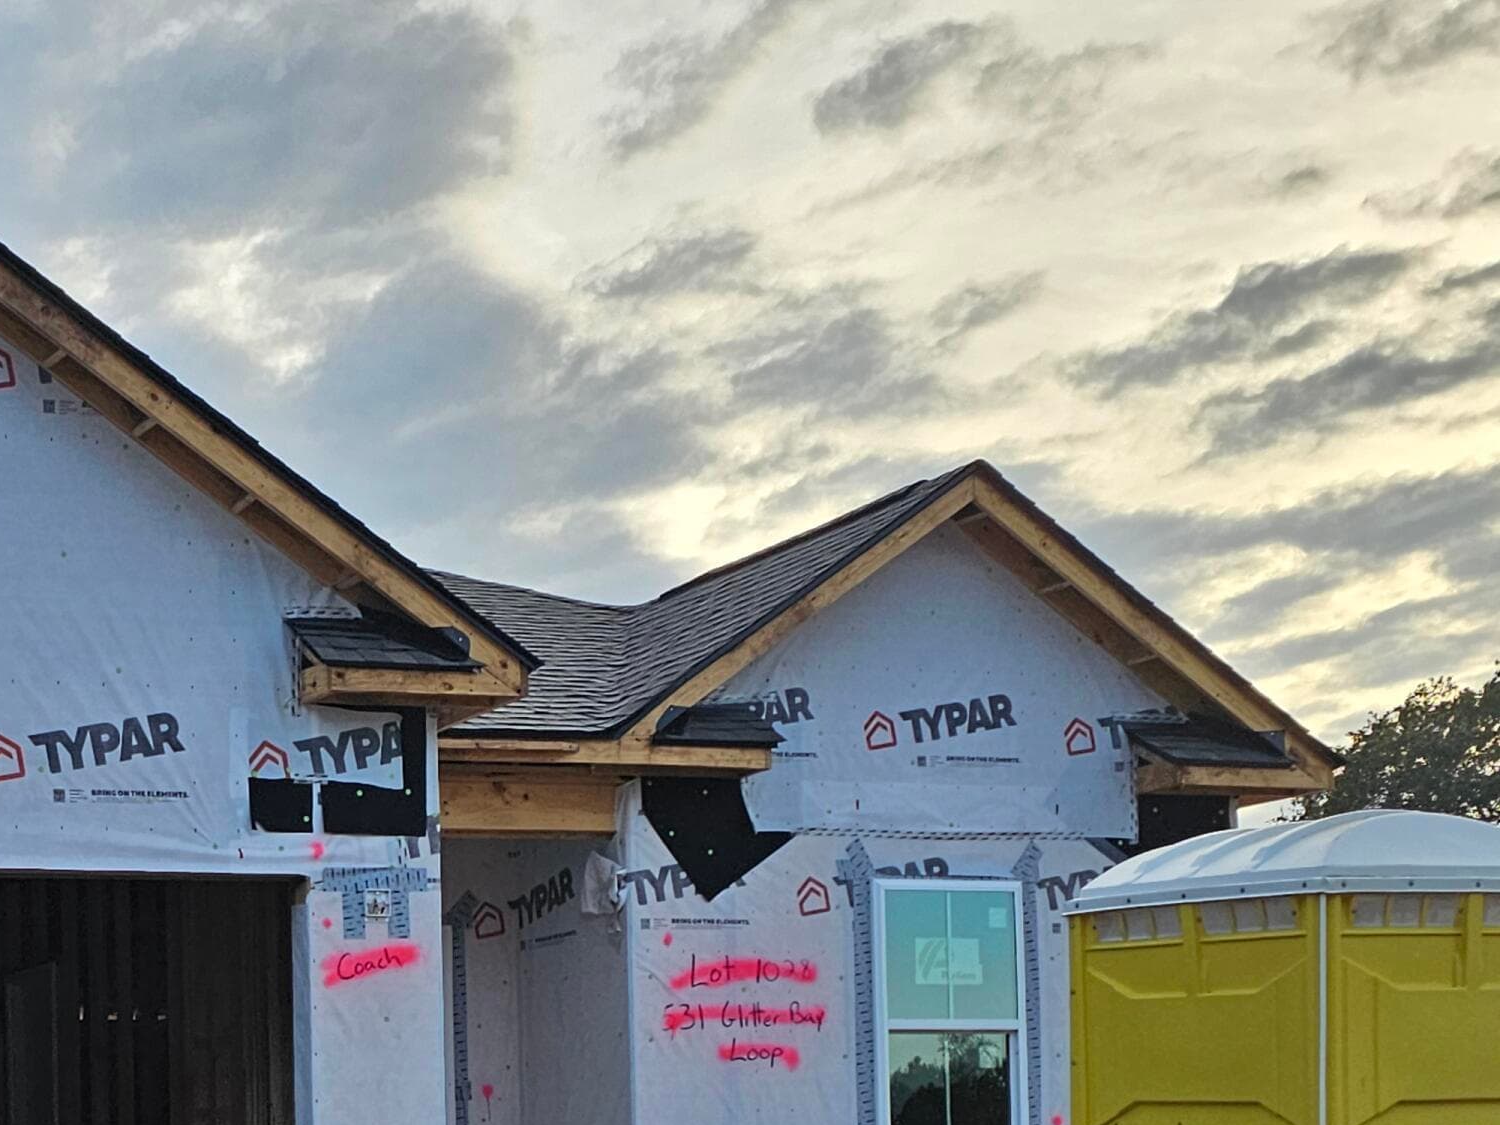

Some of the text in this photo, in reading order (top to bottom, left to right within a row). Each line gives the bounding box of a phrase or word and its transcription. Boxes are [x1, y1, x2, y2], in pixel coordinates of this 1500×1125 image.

[898, 694, 1017, 743] TYPAR
[28, 712, 185, 774] TYPAR
[507, 867, 575, 929] TYPAR
[337, 947, 403, 981] Coach
[691, 953, 736, 988] Lot
[721, 1001, 779, 1028] Glitter
[789, 1000, 825, 1032] Bay
[730, 1037, 784, 1068] Loop
